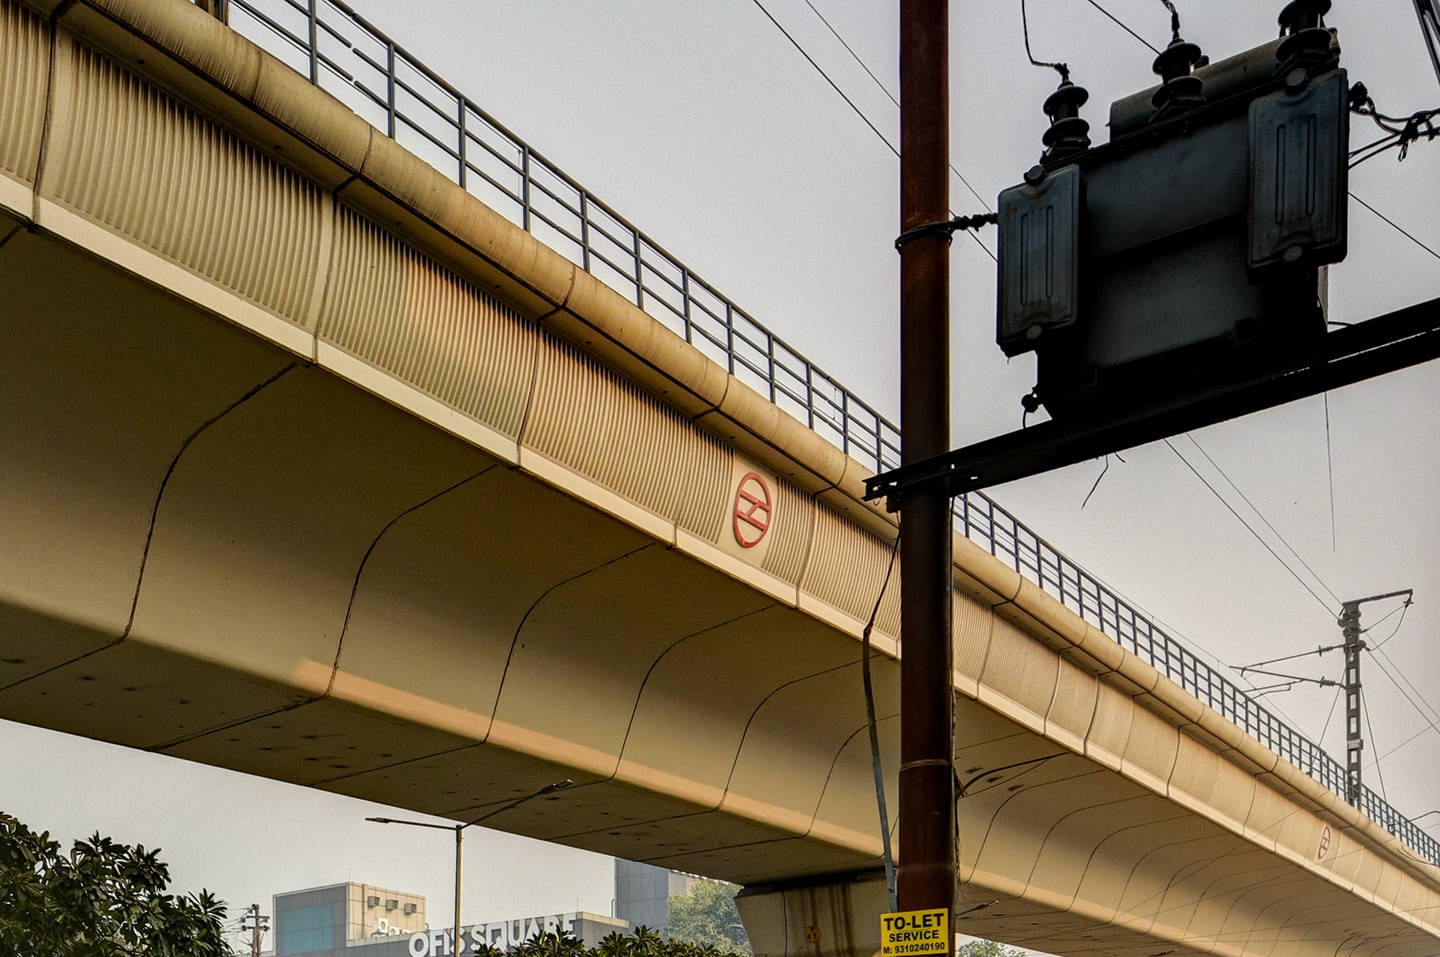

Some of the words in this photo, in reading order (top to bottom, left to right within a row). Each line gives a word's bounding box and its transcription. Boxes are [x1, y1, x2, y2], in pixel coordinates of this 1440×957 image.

[883, 913, 945, 931] TO-LET
[470, 913, 577, 954] SQUARE
[889, 930, 939, 943] SERVICE
[883, 946, 893, 954] M:
[894, 942, 945, 954] 9310240190
